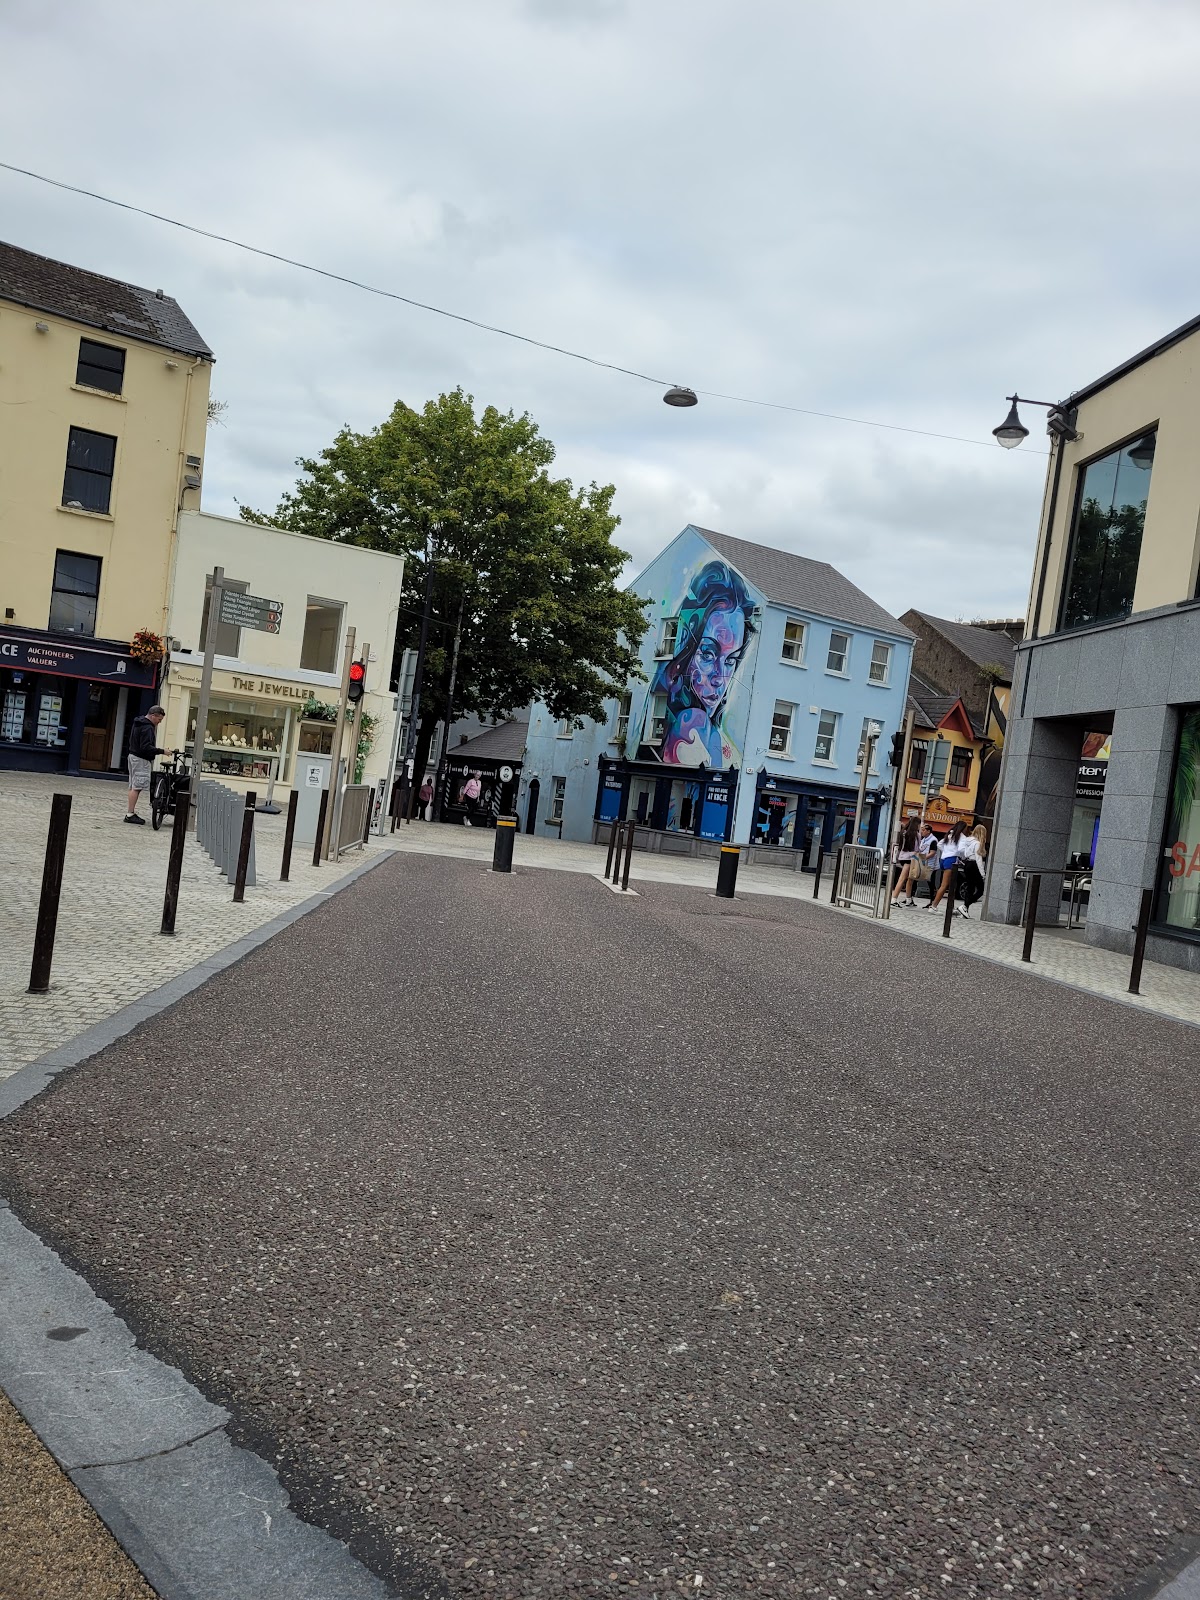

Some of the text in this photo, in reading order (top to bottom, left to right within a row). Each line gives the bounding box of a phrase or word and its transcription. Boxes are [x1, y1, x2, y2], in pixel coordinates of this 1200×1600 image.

[0, 643, 19, 657] CE
[27, 647, 75, 660] AUCTIONEERS
[27, 656, 58, 667] VALUERS
[925, 811, 961, 823] ANDOORI
